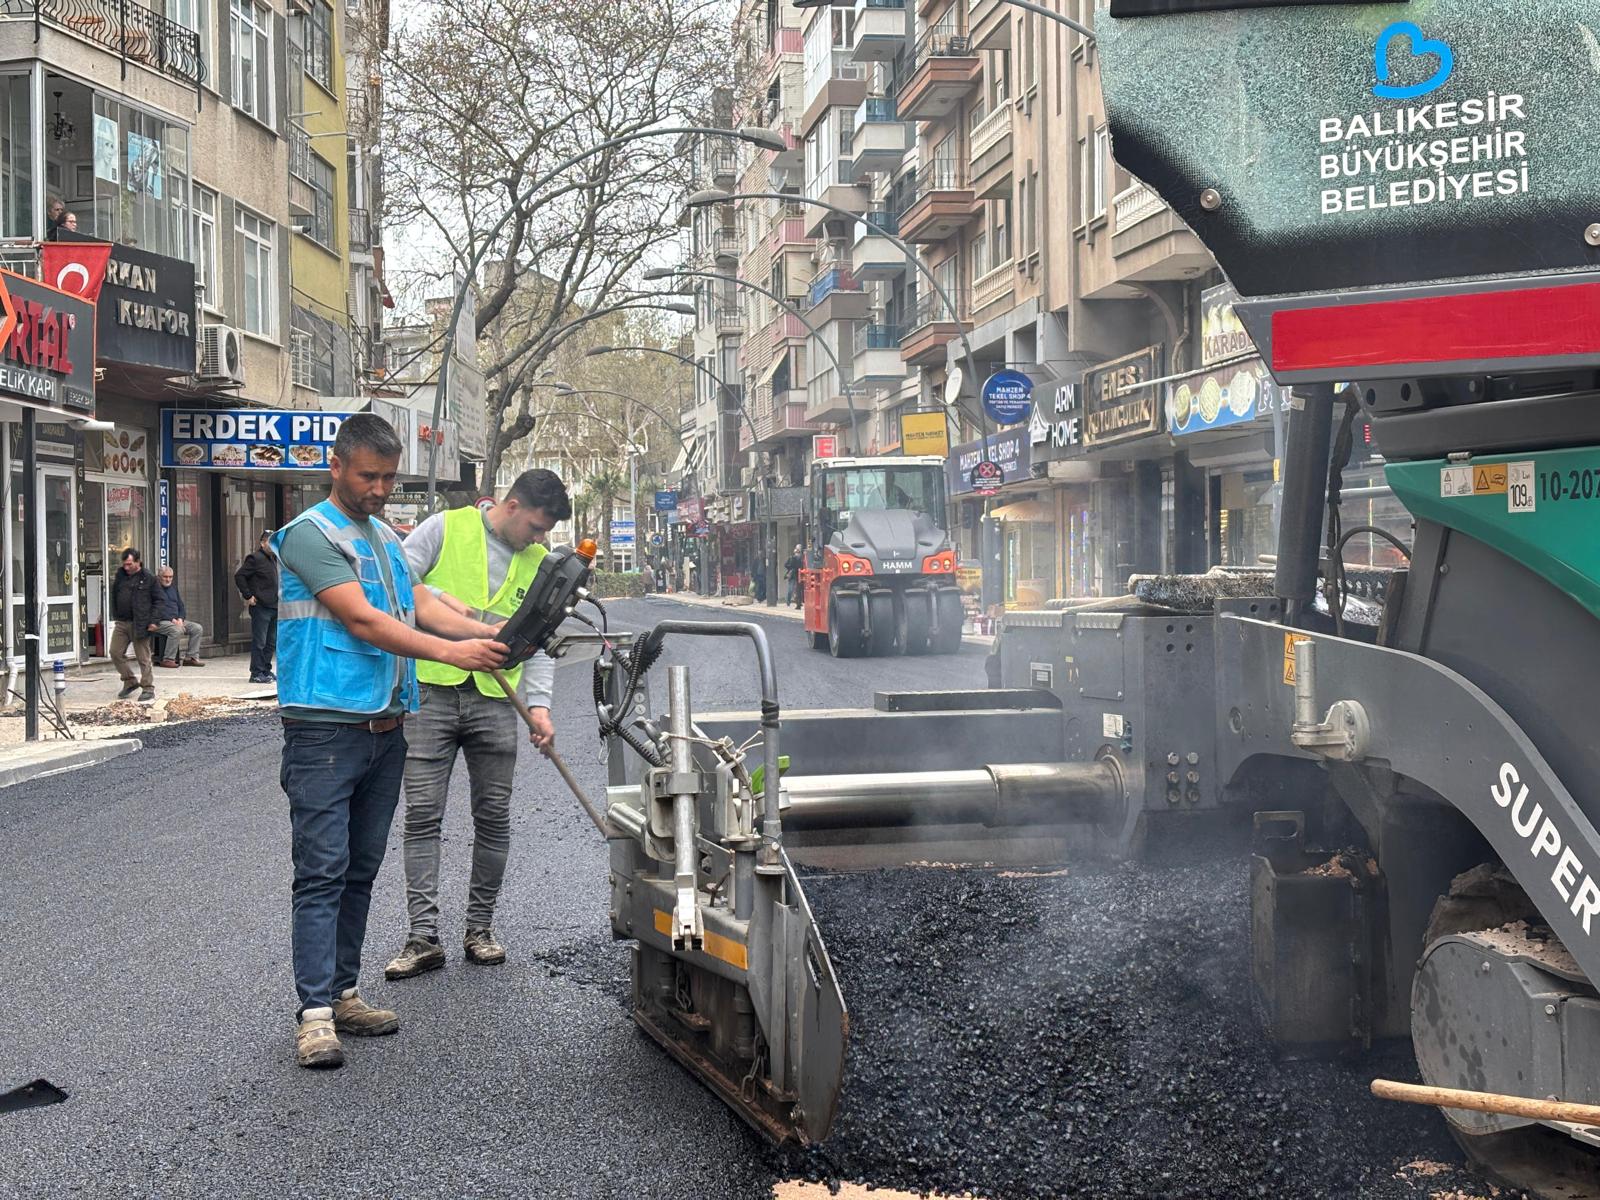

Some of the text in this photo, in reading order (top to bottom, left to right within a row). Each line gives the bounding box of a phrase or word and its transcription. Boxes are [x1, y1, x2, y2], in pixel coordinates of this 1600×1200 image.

[1319, 91, 1526, 143] BALIKESİR
[1320, 127, 1527, 179] BÜYÜKŞEHİR
[1321, 161, 1529, 215] BELEDİYESİ
[107, 259, 157, 294] RKAN
[28, 375, 54, 398] KAPI
[1055, 383, 1075, 414] ARM
[173, 414, 281, 440] ERDEK
[1051, 417, 1078, 448] HOME
[160, 486, 168, 516] KIR
[1510, 484, 1527, 507] 109
[882, 561, 913, 569] HAMM
[1491, 762, 1600, 936] SUPER
